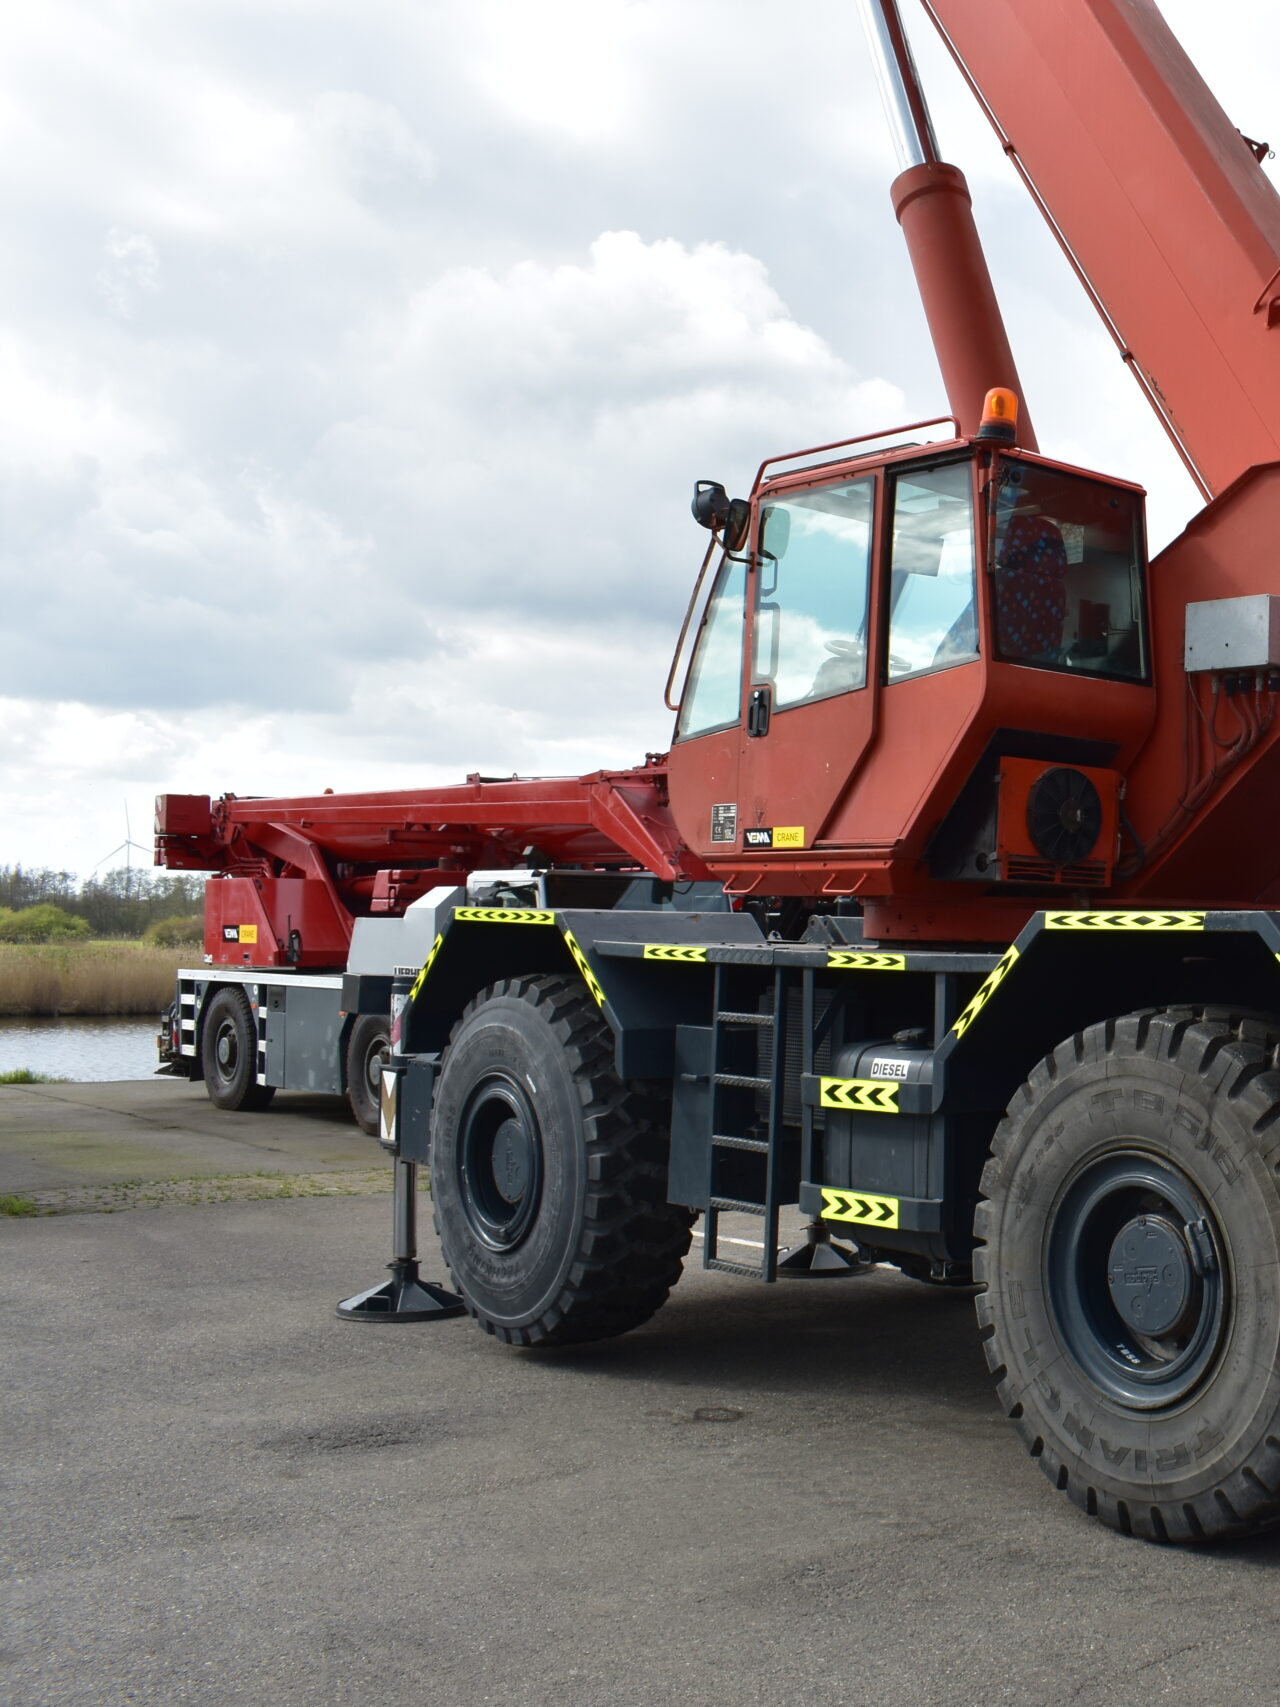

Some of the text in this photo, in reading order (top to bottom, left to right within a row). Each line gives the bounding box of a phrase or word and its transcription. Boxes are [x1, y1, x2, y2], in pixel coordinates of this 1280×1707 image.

[746, 832, 799, 844] VEMA CRANE
[872, 1063, 906, 1077] DIESEL
[1006, 1279, 1225, 1475] TRIANGLE
